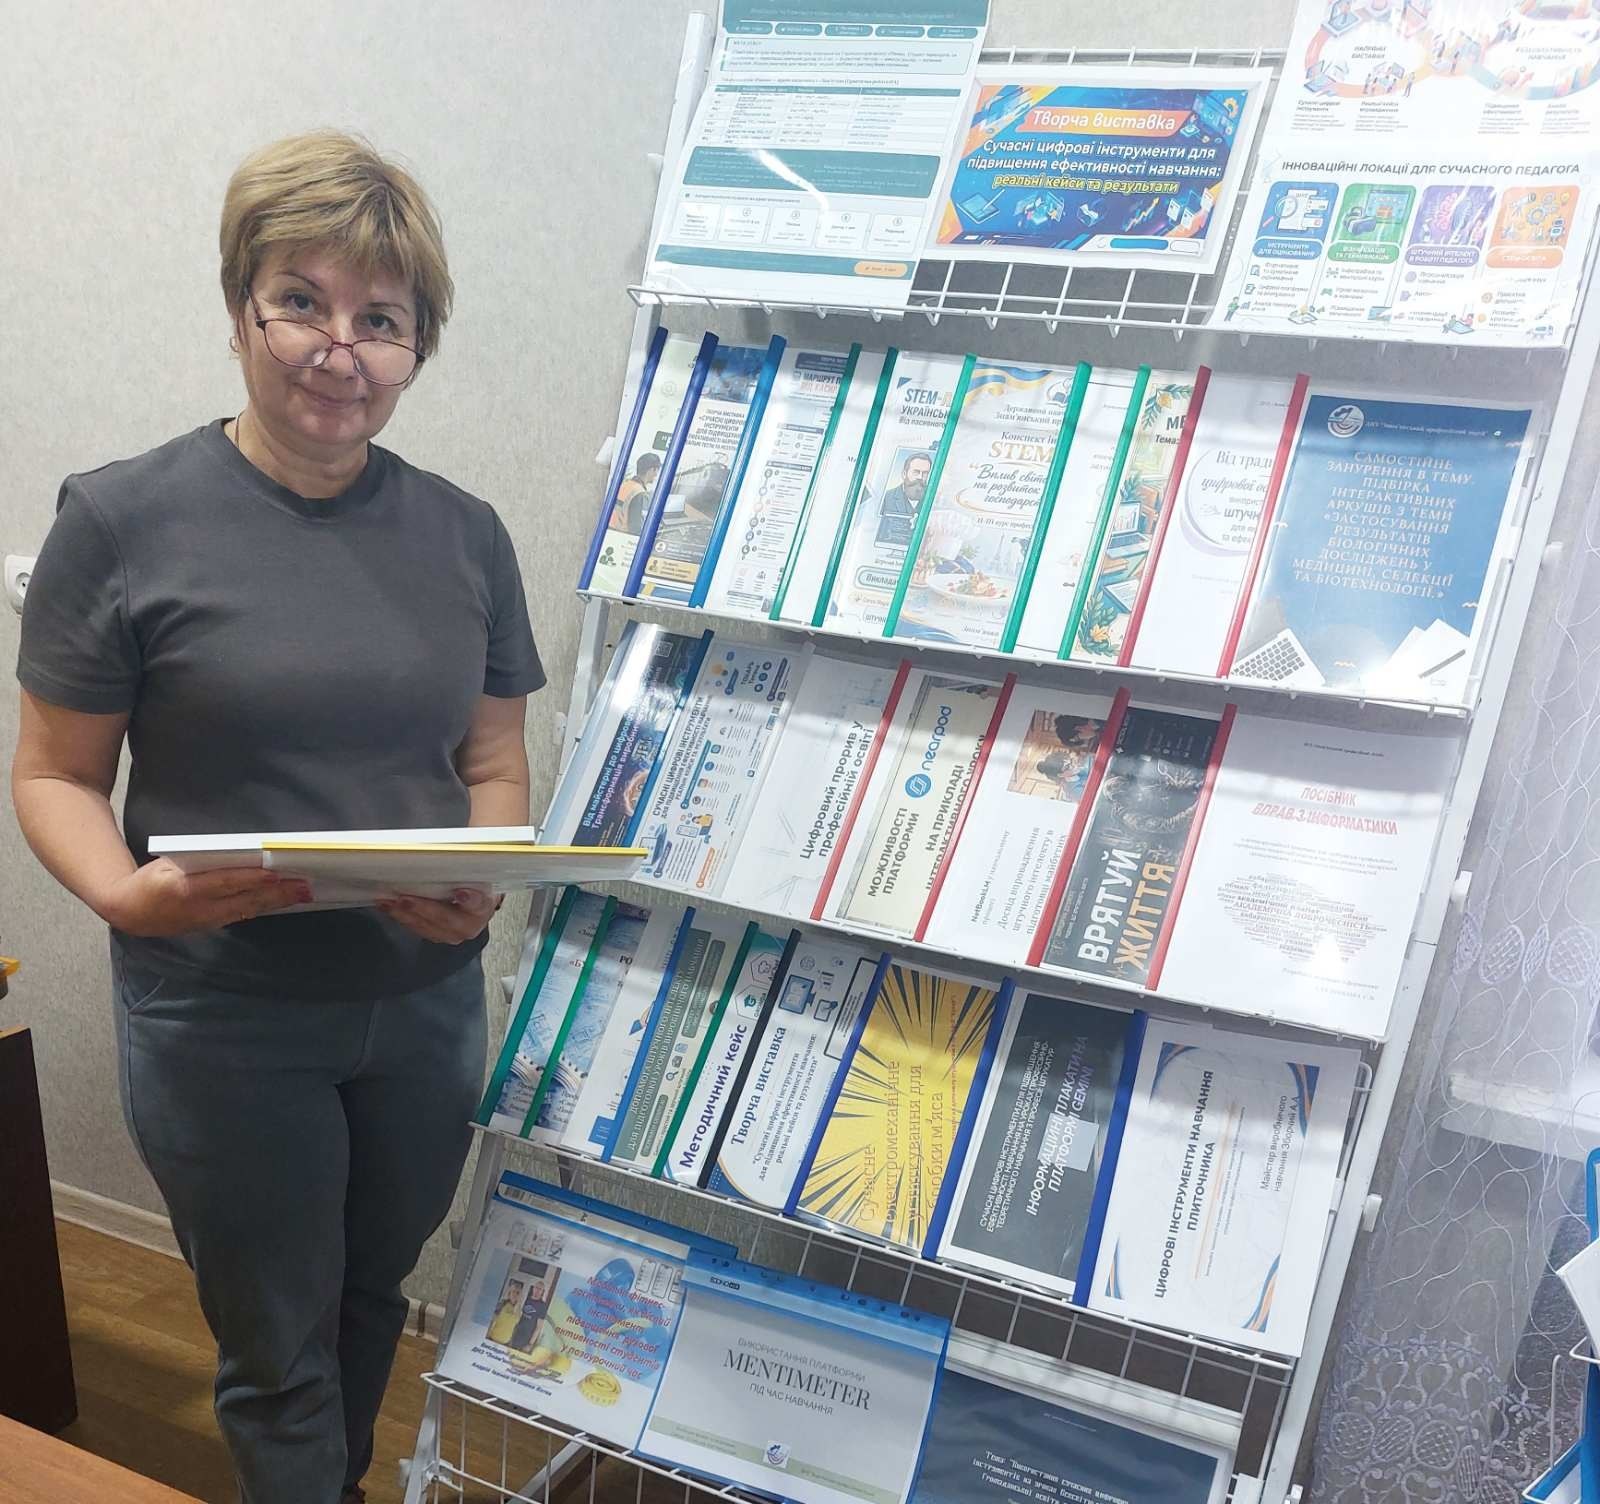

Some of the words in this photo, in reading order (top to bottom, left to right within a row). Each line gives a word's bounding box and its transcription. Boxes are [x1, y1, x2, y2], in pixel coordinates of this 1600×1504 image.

[1032, 110, 1088, 130] Творча
[1093, 110, 1175, 131] виставка
[967, 157, 1047, 172] підвищення
[1050, 160, 1146, 176] ефективності
[1149, 164, 1222, 178] навчання:
[983, 139, 1034, 155] Сучасні
[1036, 141, 1096, 158] цифрові
[1097, 142, 1184, 160] інструменти
[1188, 147, 1216, 160] для
[1282, 160, 1358, 173] ІННОВАЦІЙНІ
[1359, 163, 1410, 176] ЛОКАЦІЇ
[1410, 165, 1437, 176] ДЛЯ
[1439, 164, 1512, 176] СУЧАСНОГО
[1515, 163, 1581, 177] ПЕДАГОГА
[993, 175, 1044, 189] реальні
[1046, 177, 1085, 189] кейси
[1087, 180, 1102, 191] та
[1102, 181, 1179, 194] результати
[1001, 432, 1045, 444] Конспект
[1216, 450, 1236, 465] Від
[1327, 460, 1411, 479] ЗАНУРЕННЯ
[1417, 470, 1426, 480] В
[1354, 451, 1453, 470] САМОСТІЙНЕ
[1331, 487, 1457, 509] ІНТЕРАКТИВНИХ
[1362, 477, 1430, 493] ПІДБІРКА
[1327, 500, 1391, 515] АРКУШІВ
[1396, 506, 1404, 516] З
[1410, 508, 1452, 521] ТЕМИ
[1327, 537, 1431, 557] БІОЛОГІЧНИХ
[1334, 526, 1431, 545] РЕЗУЛЬТАТІВ
[1294, 570, 1315, 582] ТА
[1318, 548, 1418, 570] ДОСЛІДЖЕНЬ
[1424, 561, 1433, 571] У
[1382, 568, 1454, 587] СЕЛЕКЦІЇ
[652, 782, 670, 816] СУЧАСНІ
[665, 748, 684, 783] ЦИФРОВІ
[679, 697, 705, 746] ІНСТРУМЕНТИ
[922, 705, 952, 770] nearpod
[582, 812, 593, 827] Від
[590, 766, 612, 811] майстерні
[609, 754, 619, 767] до
[592, 764, 619, 829] Трансформація
[800, 785, 838, 859] Цифровий
[831, 731, 858, 783] прорив
[852, 720, 864, 730] у
[819, 769, 859, 857] професійній
[852, 728, 874, 767] освіті
[925, 831, 941, 852] НА
[934, 764, 963, 828] ПРИКЛАДІ
[1300, 786, 1357, 807] ПОСІБНИК
[1251, 802, 1295, 820] ВПРАВ
[1306, 809, 1399, 835] ІНФОРМАТИКИ
[867, 806, 907, 896] МОЖЛИВОСТІ
[881, 812, 920, 894] ПЛАТФОРМИ
[998, 896, 1015, 929] Досвід
[1012, 884, 1033, 931] штучного
[1078, 848, 1142, 963] ВРЯТУЙ
[1113, 862, 1176, 970] ЖИТТЯ
[680, 1064, 731, 1168] Методичний
[727, 1023, 747, 1061] кейс
[731, 1095, 761, 1147] Творча
[758, 1027, 786, 1091] виставка
[1019, 1091, 1034, 1120] УРОКАХ
[1055, 1056, 1083, 1116] ПЛАКАТИ
[1072, 1066, 1095, 1112] GEMINI
[884, 1060, 900, 1222] електромеханічне
[1016, 1120, 1025, 1131] НА
[1260, 1152, 1275, 1190] Майстер
[1271, 1094, 1288, 1151] виробничого
[978, 1195, 994, 1227] СУЧАСНІ
[988, 1158, 1005, 1195] ЦИФРОВІ
[999, 1107, 1020, 1158] ІНСТРУМЕНТИ
[1004, 1132, 1021, 1172] НАВЧАННЯ
[1274, 1149, 1290, 1192] навчання
[995, 1171, 1019, 1229] ТЕОРЕТИЧНОГО
[1013, 1129, 1031, 1170] НАВЧАННЯ
[1154, 1236, 1177, 1298] ЦИФРОВІ
[1168, 1143, 1197, 1233] ІНСТРУМЕНТИ
[1193, 1070, 1214, 1141] НАВЧАННЯ
[1187, 1142, 1216, 1231] ПЛИТОЧНИКА
[985, 1174, 1009, 1232] ЕФЕКТИВНОСТІ
[723, 1348, 870, 1410] MENTIMETER
[738, 1337, 808, 1365] ВИКОРИСТАННЯ
[809, 1359, 866, 1382] ПЛАТФОРМИ
[750, 1382, 765, 1394] ПІД
[766, 1388, 785, 1400] ЧАС
[785, 1392, 834, 1415] НАВЧАННЯ
